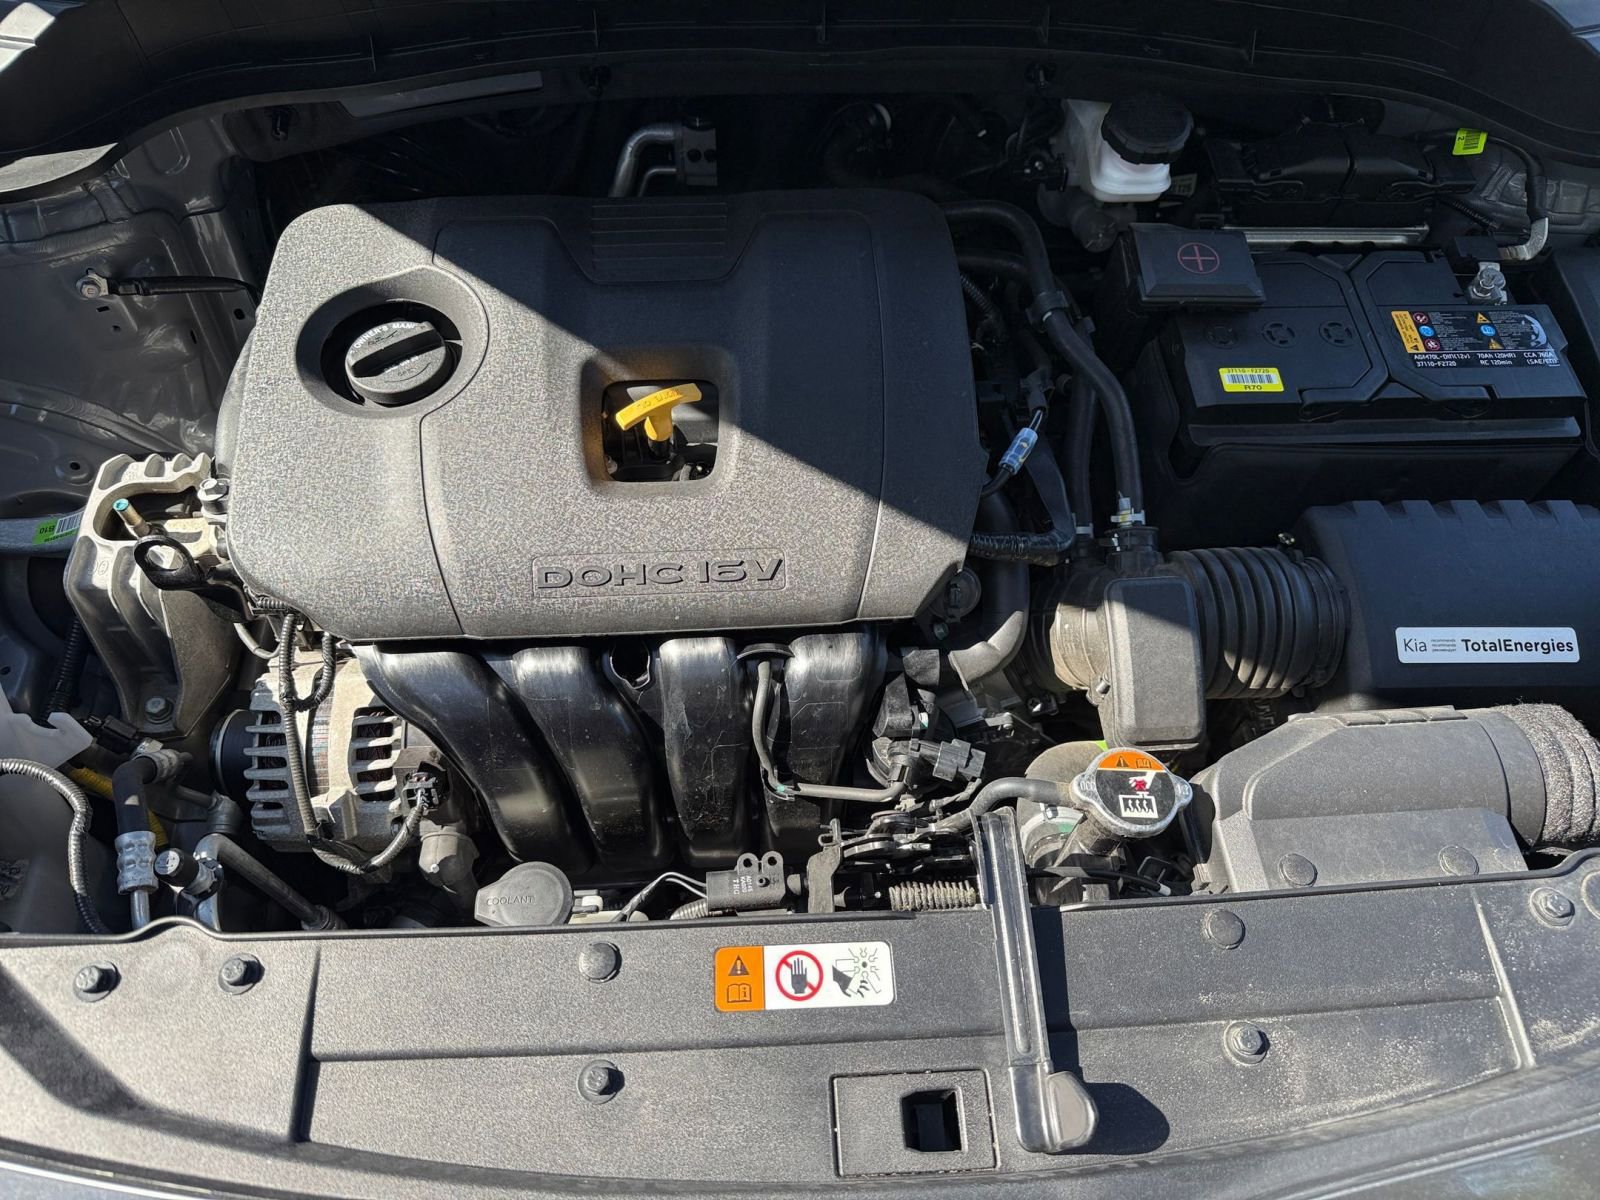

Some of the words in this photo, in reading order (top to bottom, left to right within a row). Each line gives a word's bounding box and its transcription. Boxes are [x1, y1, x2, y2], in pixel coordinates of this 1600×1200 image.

[537, 562, 684, 589] DOHC
[699, 558, 783, 584] 16V
[1403, 638, 1427, 652] Kia
[1461, 638, 1574, 655] TotalEnergies
[486, 895, 536, 907] COOLANT
